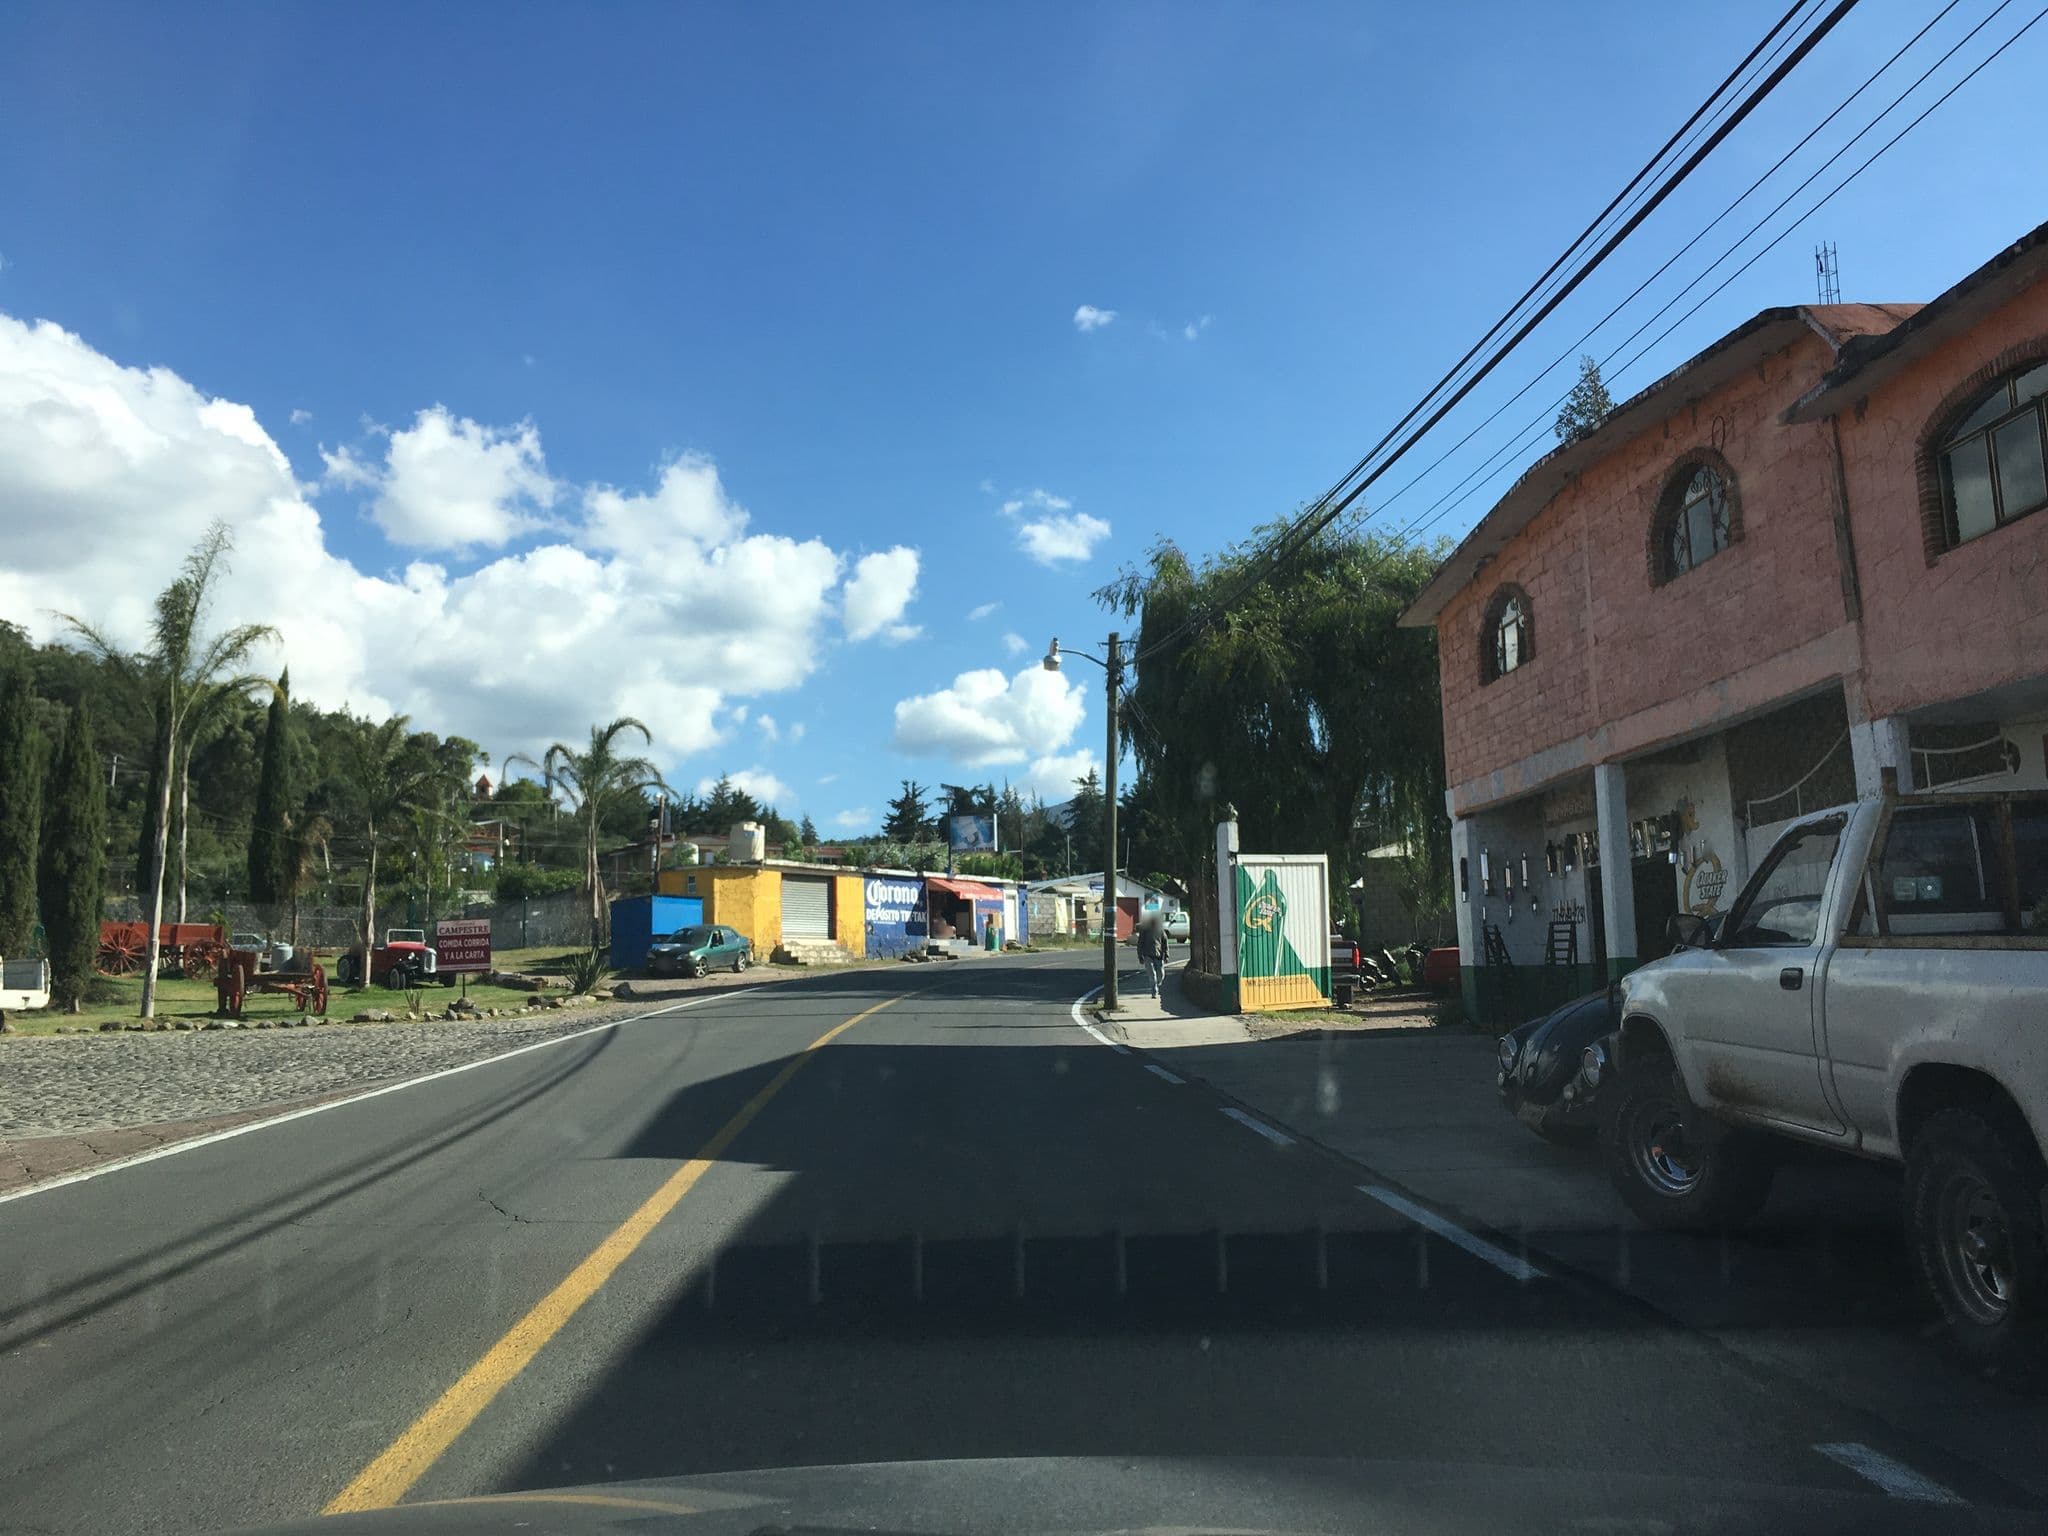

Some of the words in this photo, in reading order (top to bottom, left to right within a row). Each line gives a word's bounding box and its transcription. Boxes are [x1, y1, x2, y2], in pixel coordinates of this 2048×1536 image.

[1696, 870, 1728, 888] QUAKER
[1700, 885, 1723, 900] STATE
[439, 926, 488, 935] CAMPESTRE
[439, 940, 463, 948] COMIDA
[464, 938, 490, 947] CORRIDA
[444, 952, 449, 960] Y
[450, 952, 455, 960] A
[456, 952, 464, 960] LA
[465, 951, 485, 960] CARTA
